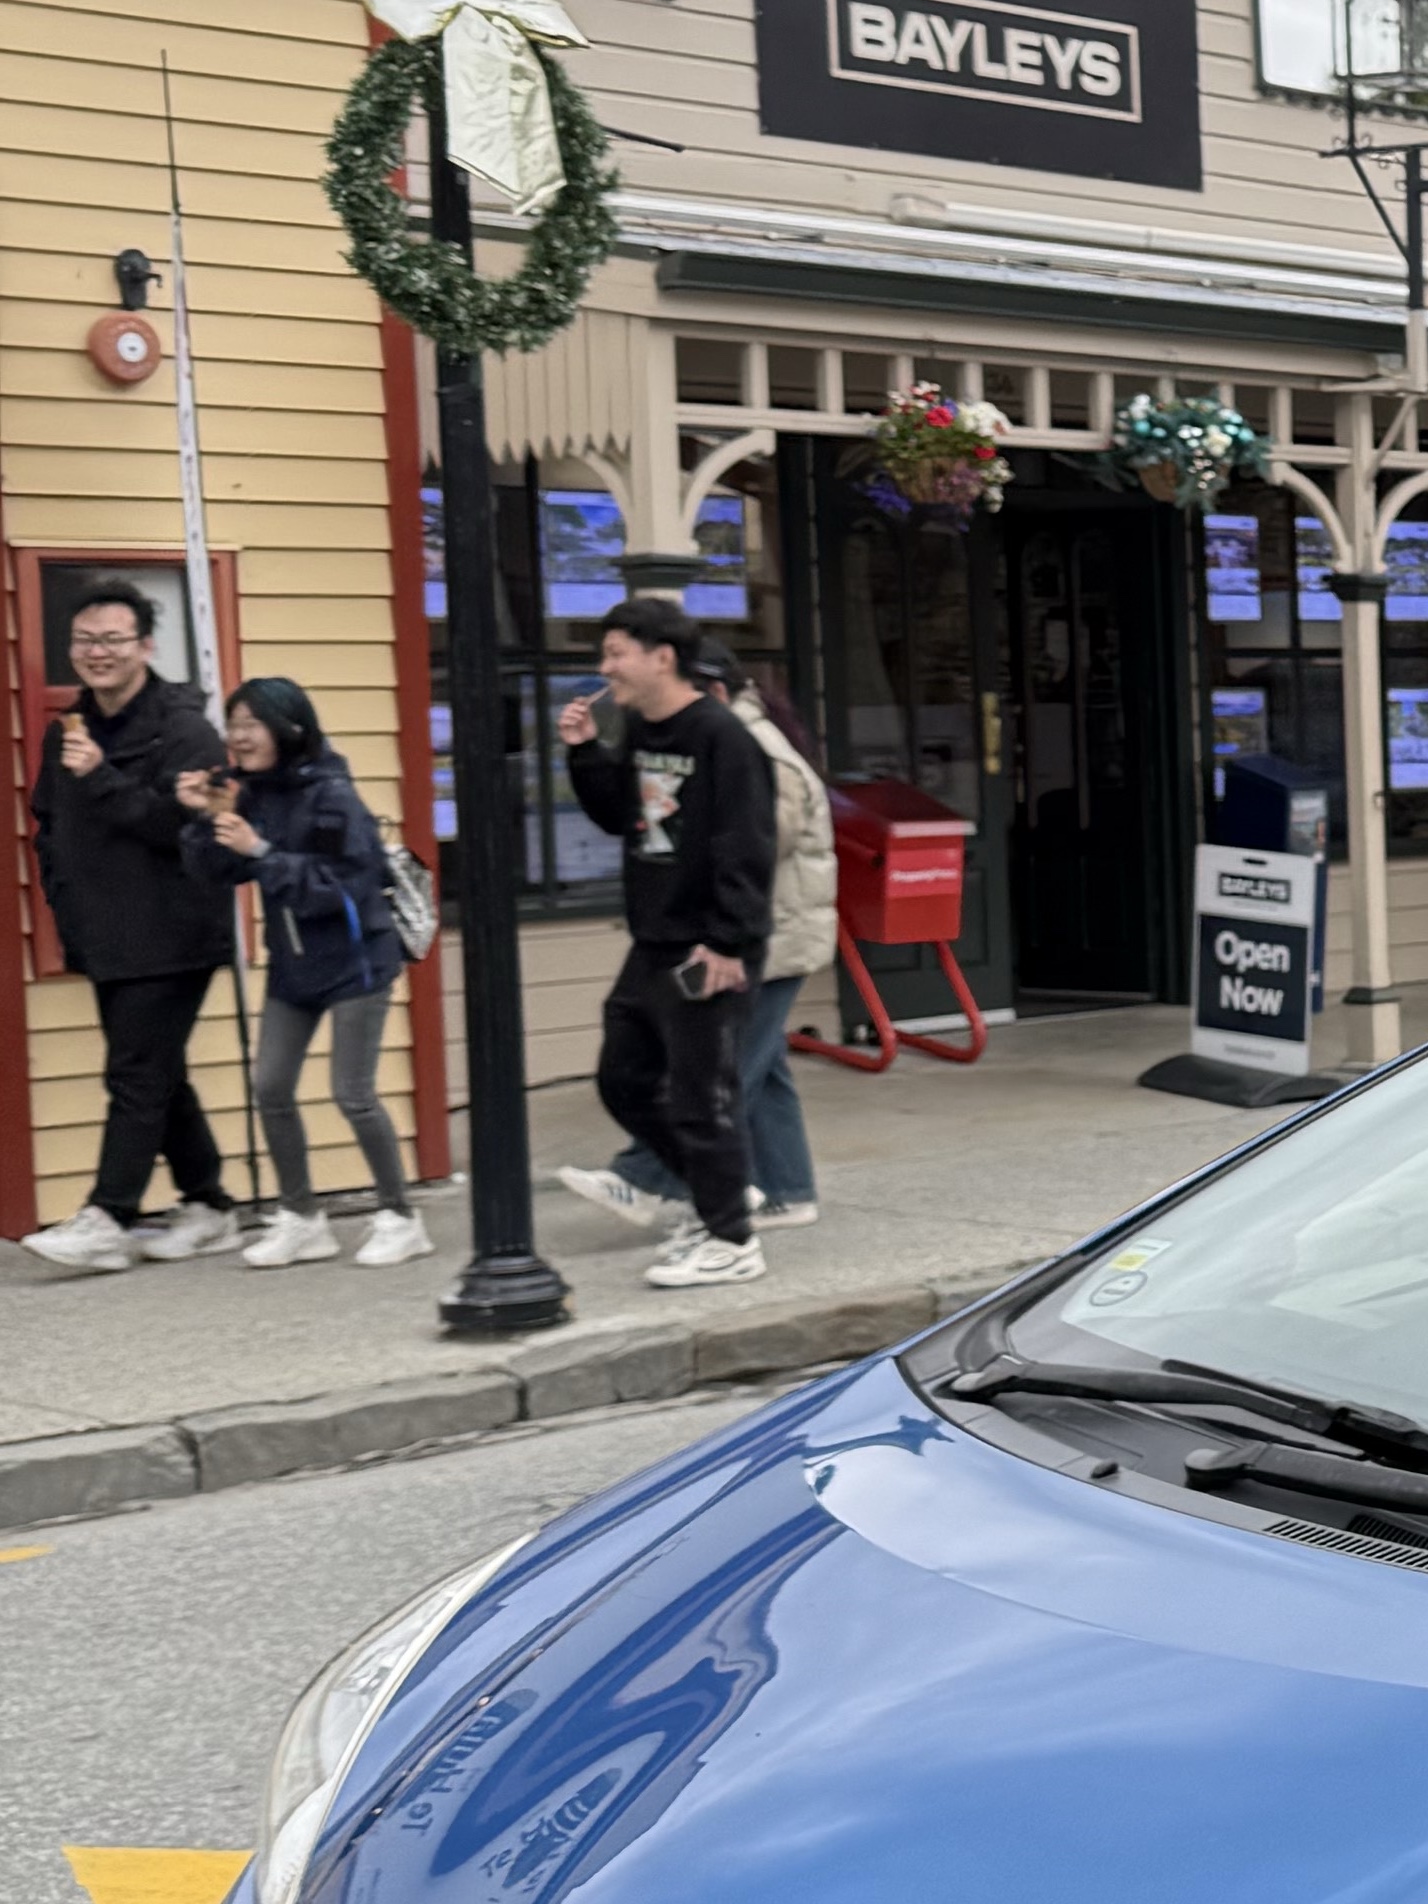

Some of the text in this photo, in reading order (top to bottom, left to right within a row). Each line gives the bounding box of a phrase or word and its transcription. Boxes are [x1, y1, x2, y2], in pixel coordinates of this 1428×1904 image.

[848, 1, 1121, 97] BAYLEYS
[1214, 930, 1291, 973] Open
[1219, 975, 1283, 1017] Now
